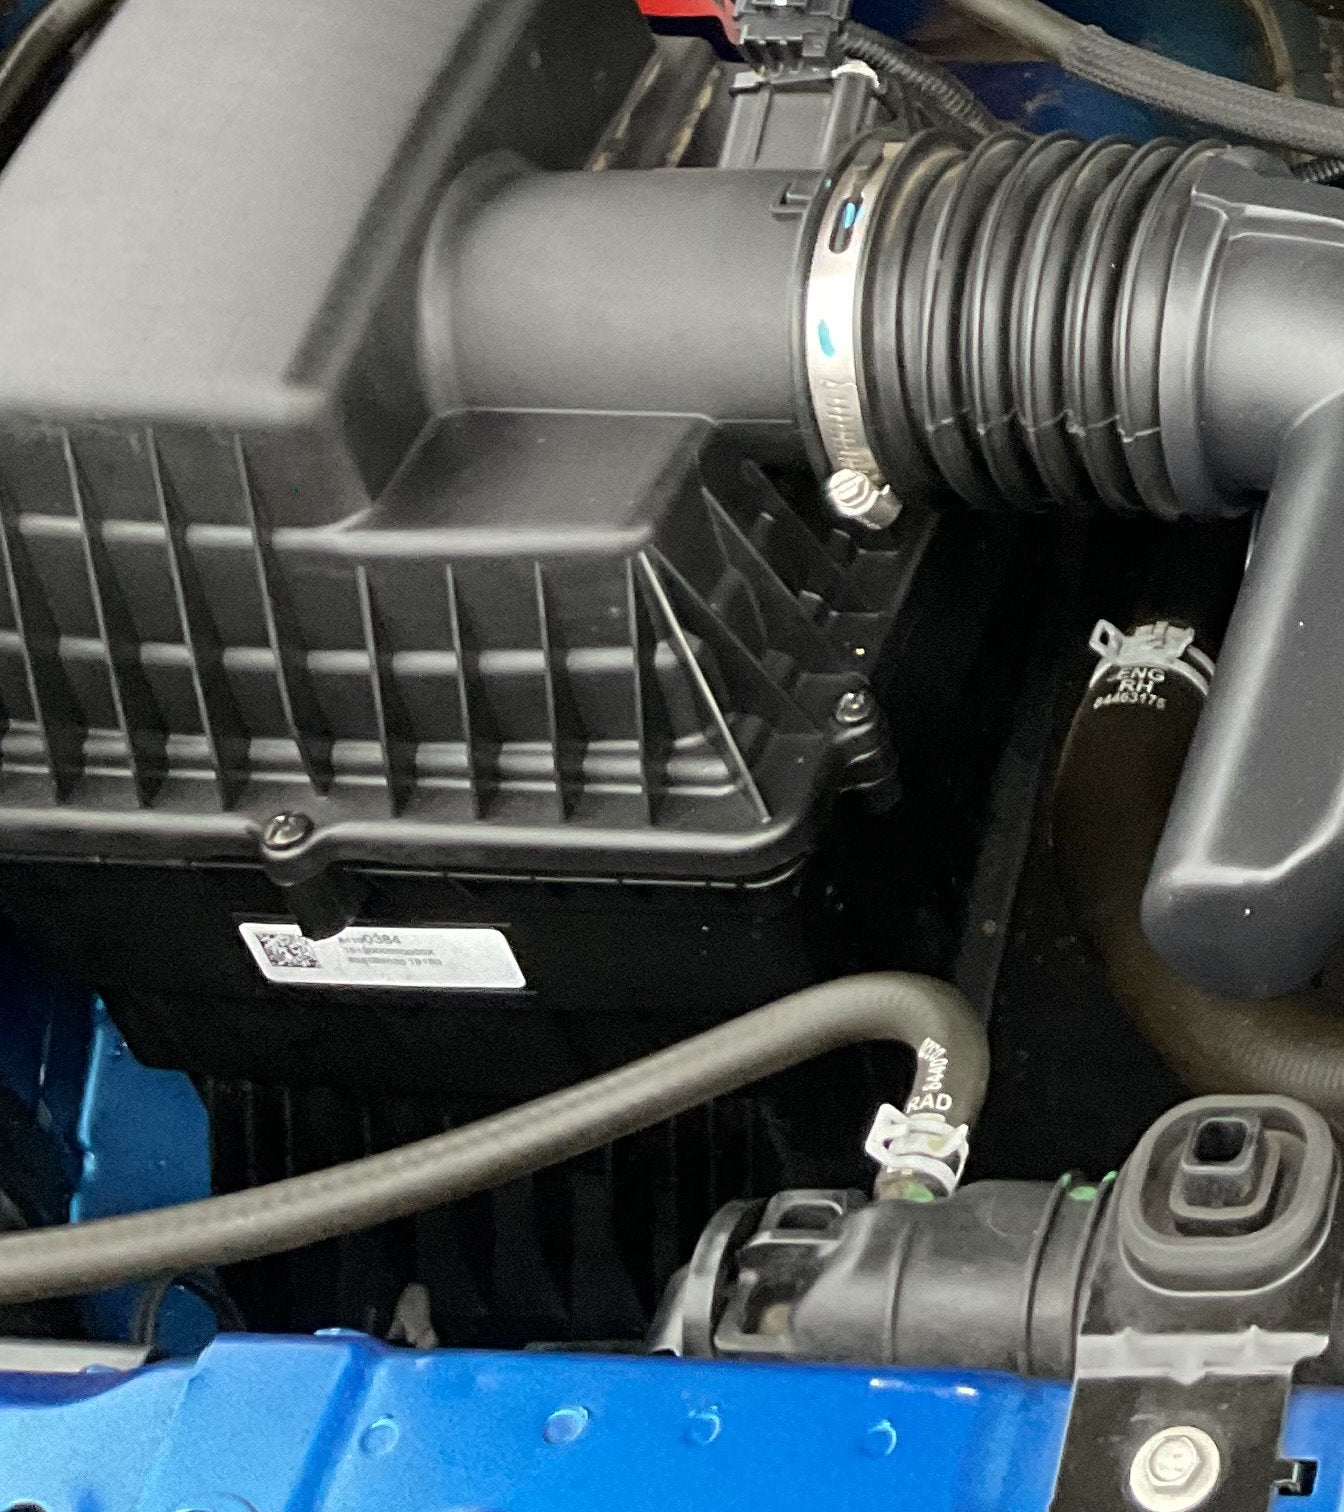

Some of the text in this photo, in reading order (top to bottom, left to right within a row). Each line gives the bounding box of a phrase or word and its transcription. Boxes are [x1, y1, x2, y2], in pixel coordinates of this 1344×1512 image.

[1117, 667, 1165, 683] ENG
[1120, 679, 1155, 694] RH
[905, 1093, 953, 1114] RAD
